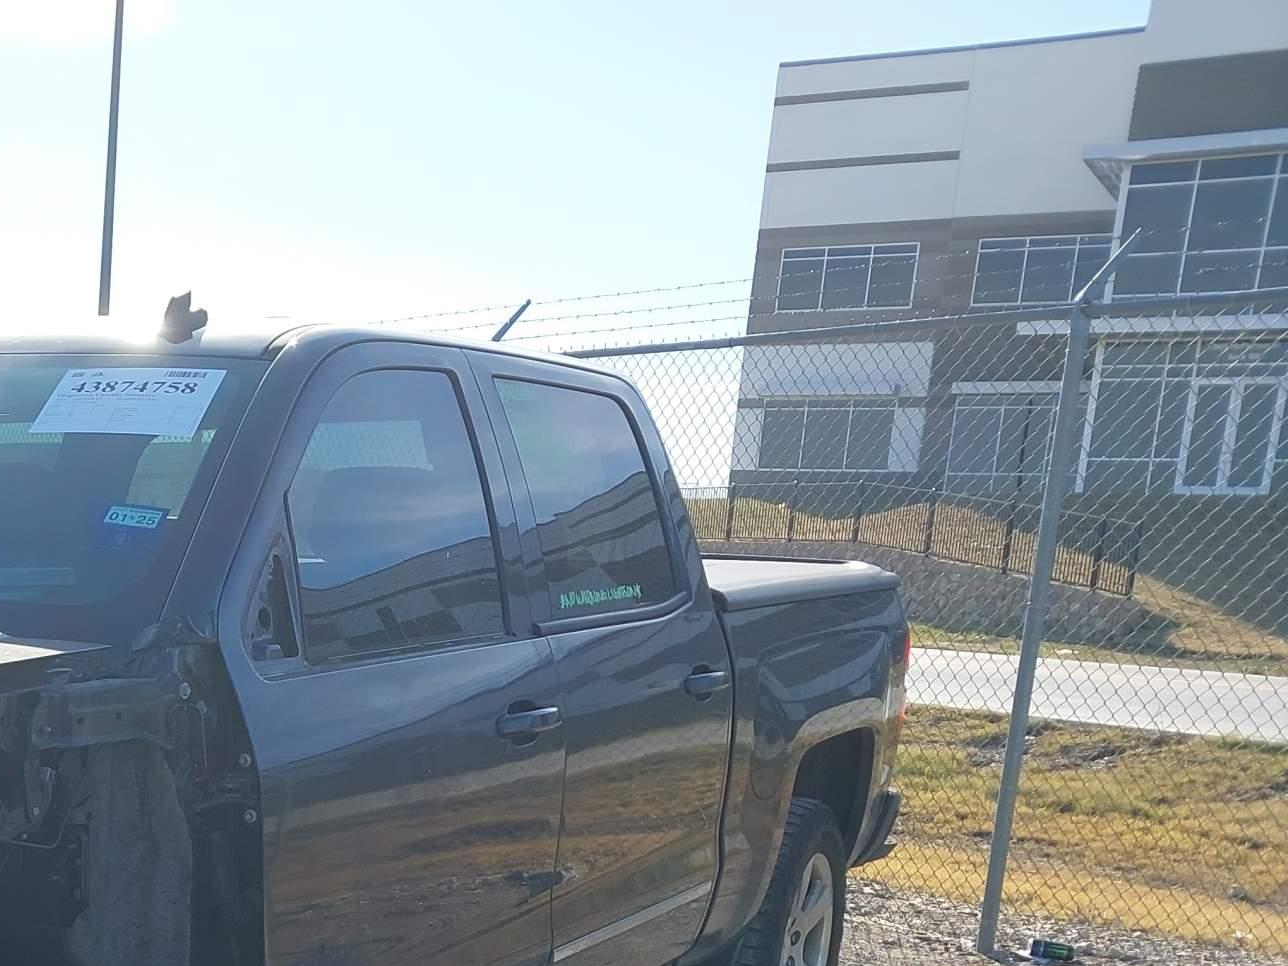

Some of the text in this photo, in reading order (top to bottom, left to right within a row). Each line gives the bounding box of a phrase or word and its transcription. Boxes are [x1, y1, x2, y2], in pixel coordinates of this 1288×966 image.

[71, 380, 199, 394] 43874758
[108, 511, 158, 526] 01 25
